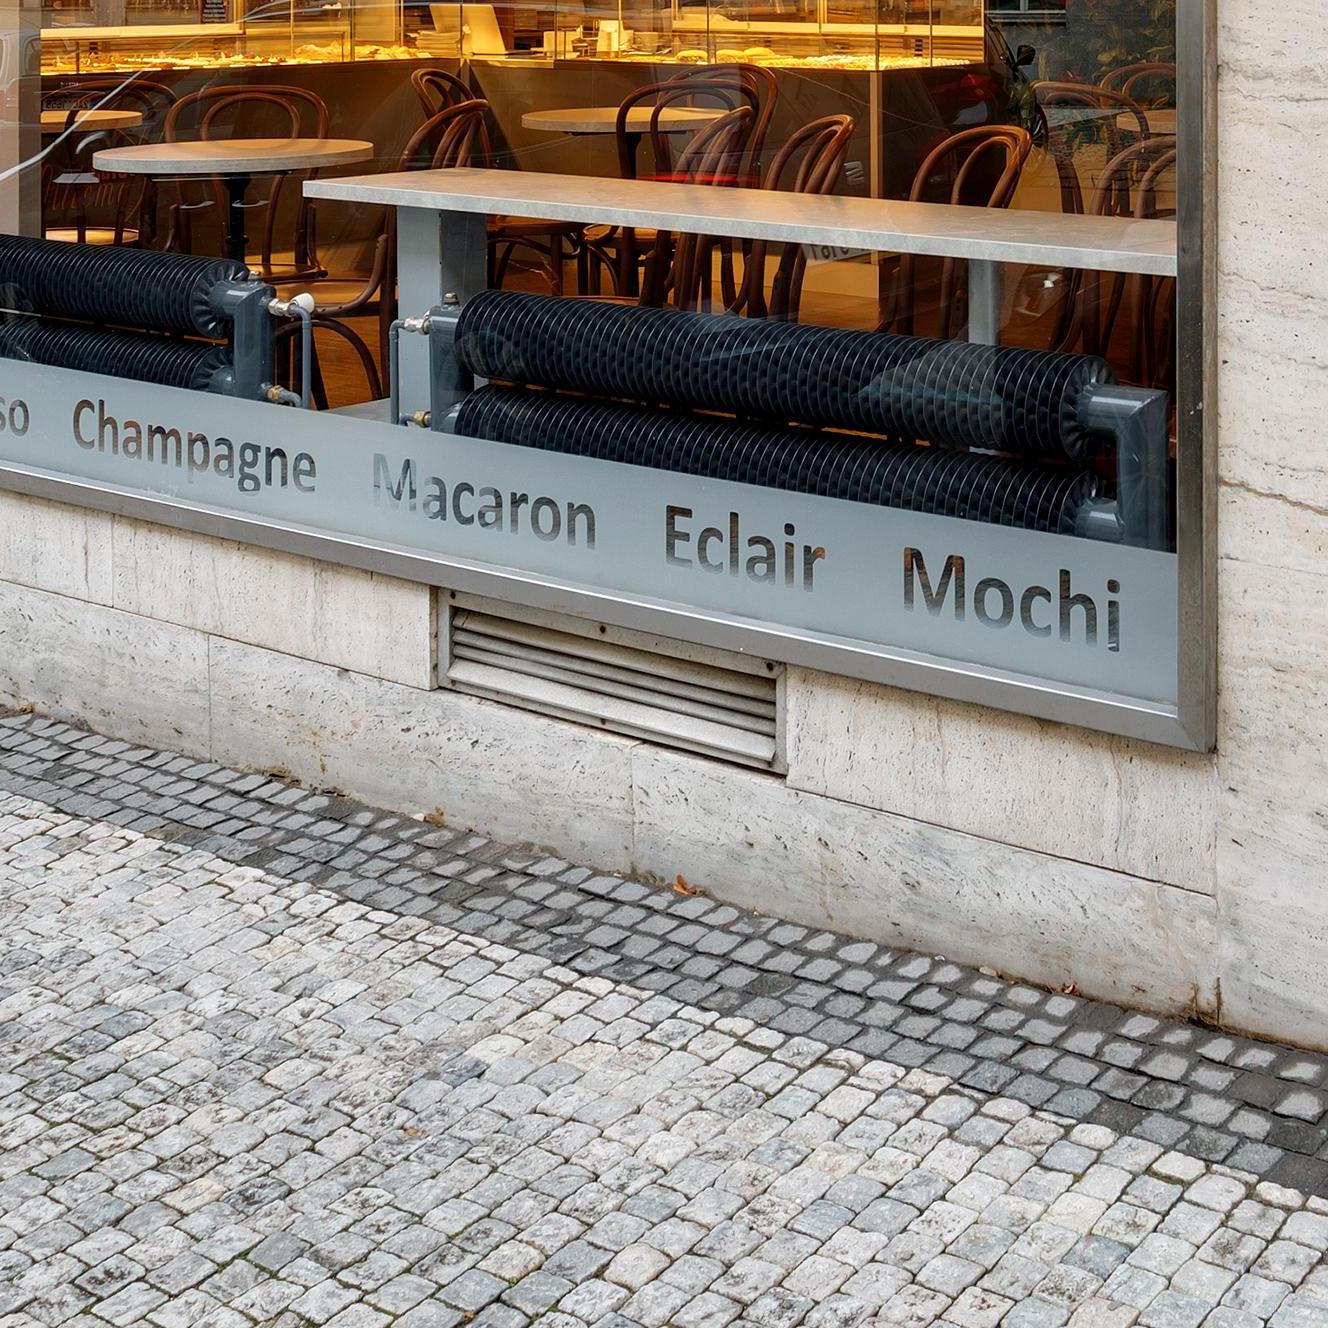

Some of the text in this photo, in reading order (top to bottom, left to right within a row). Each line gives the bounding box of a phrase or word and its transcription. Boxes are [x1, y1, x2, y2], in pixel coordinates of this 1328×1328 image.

[73, 399, 318, 494] Champagne
[371, 452, 597, 549] Macaron
[666, 504, 826, 594] Eclair
[902, 546, 1123, 654] Mochi
